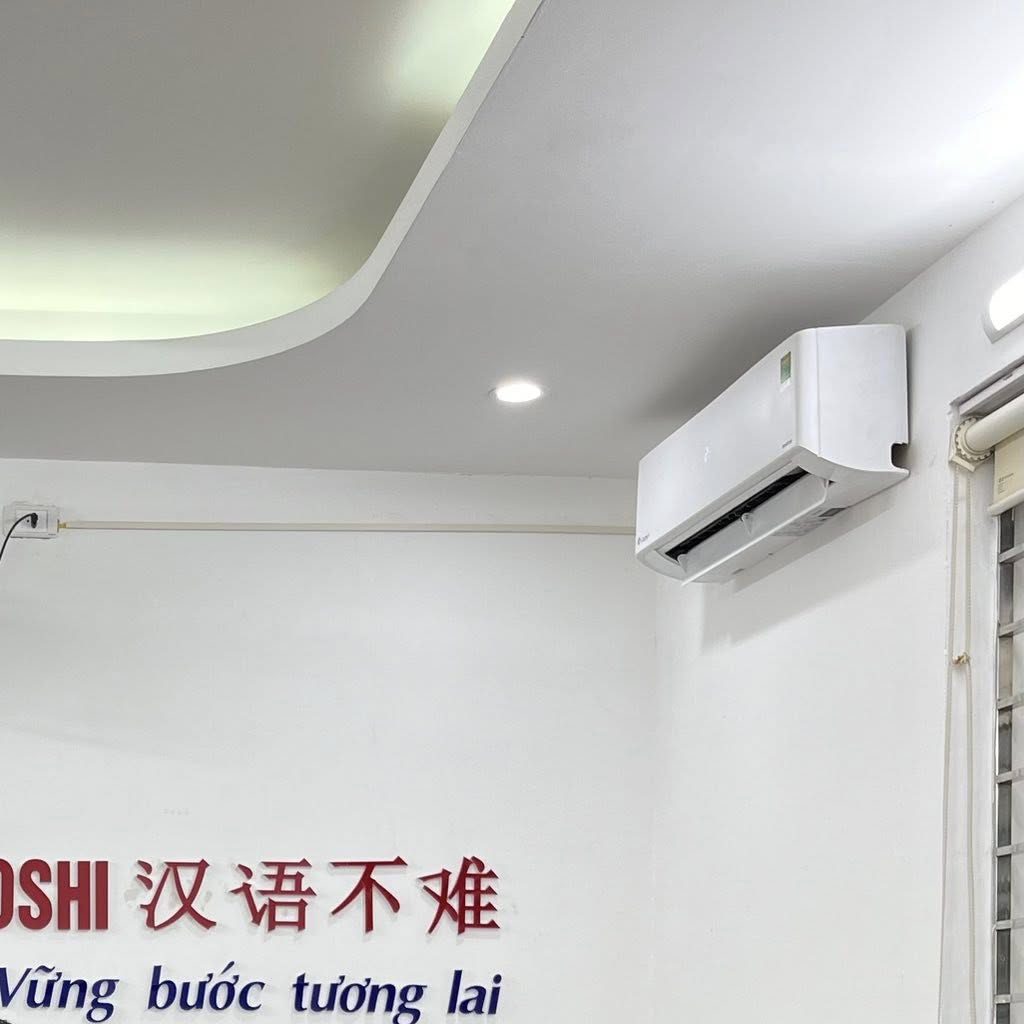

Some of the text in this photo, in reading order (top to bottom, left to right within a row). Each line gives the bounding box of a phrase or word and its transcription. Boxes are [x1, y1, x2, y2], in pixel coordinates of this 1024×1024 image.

[136, 856, 500, 935] 汉语不难
[147, 961, 265, 1011] bước
[447, 969, 502, 1016] lai
